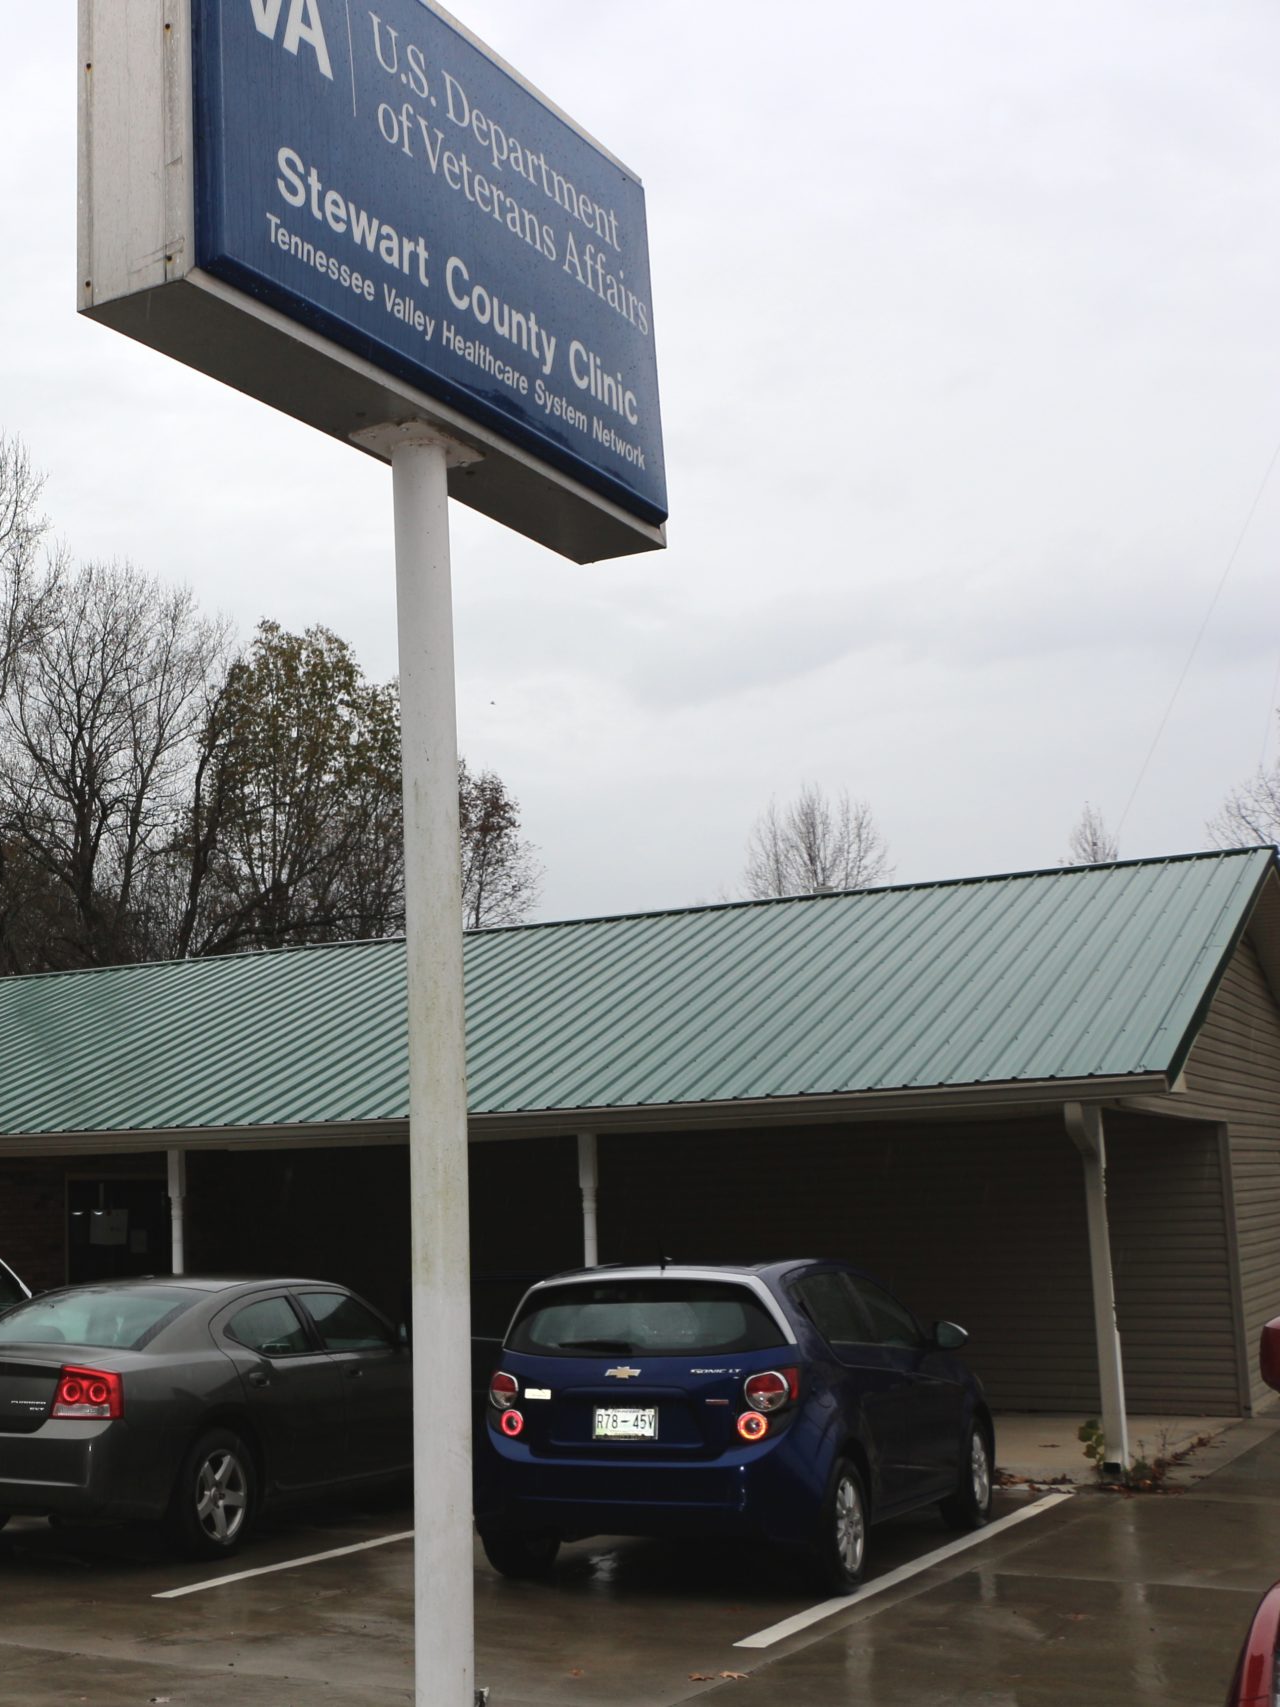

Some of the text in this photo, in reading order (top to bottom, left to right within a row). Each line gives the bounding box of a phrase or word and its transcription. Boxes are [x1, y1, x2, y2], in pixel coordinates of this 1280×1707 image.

[368, 12, 621, 253] U.S. Department
[378, 103, 649, 336] of Veterans Affairs
[266, 212, 646, 471] Tennessee Valley Healthcare System Network
[276, 147, 639, 425] Stewart County Clinic
